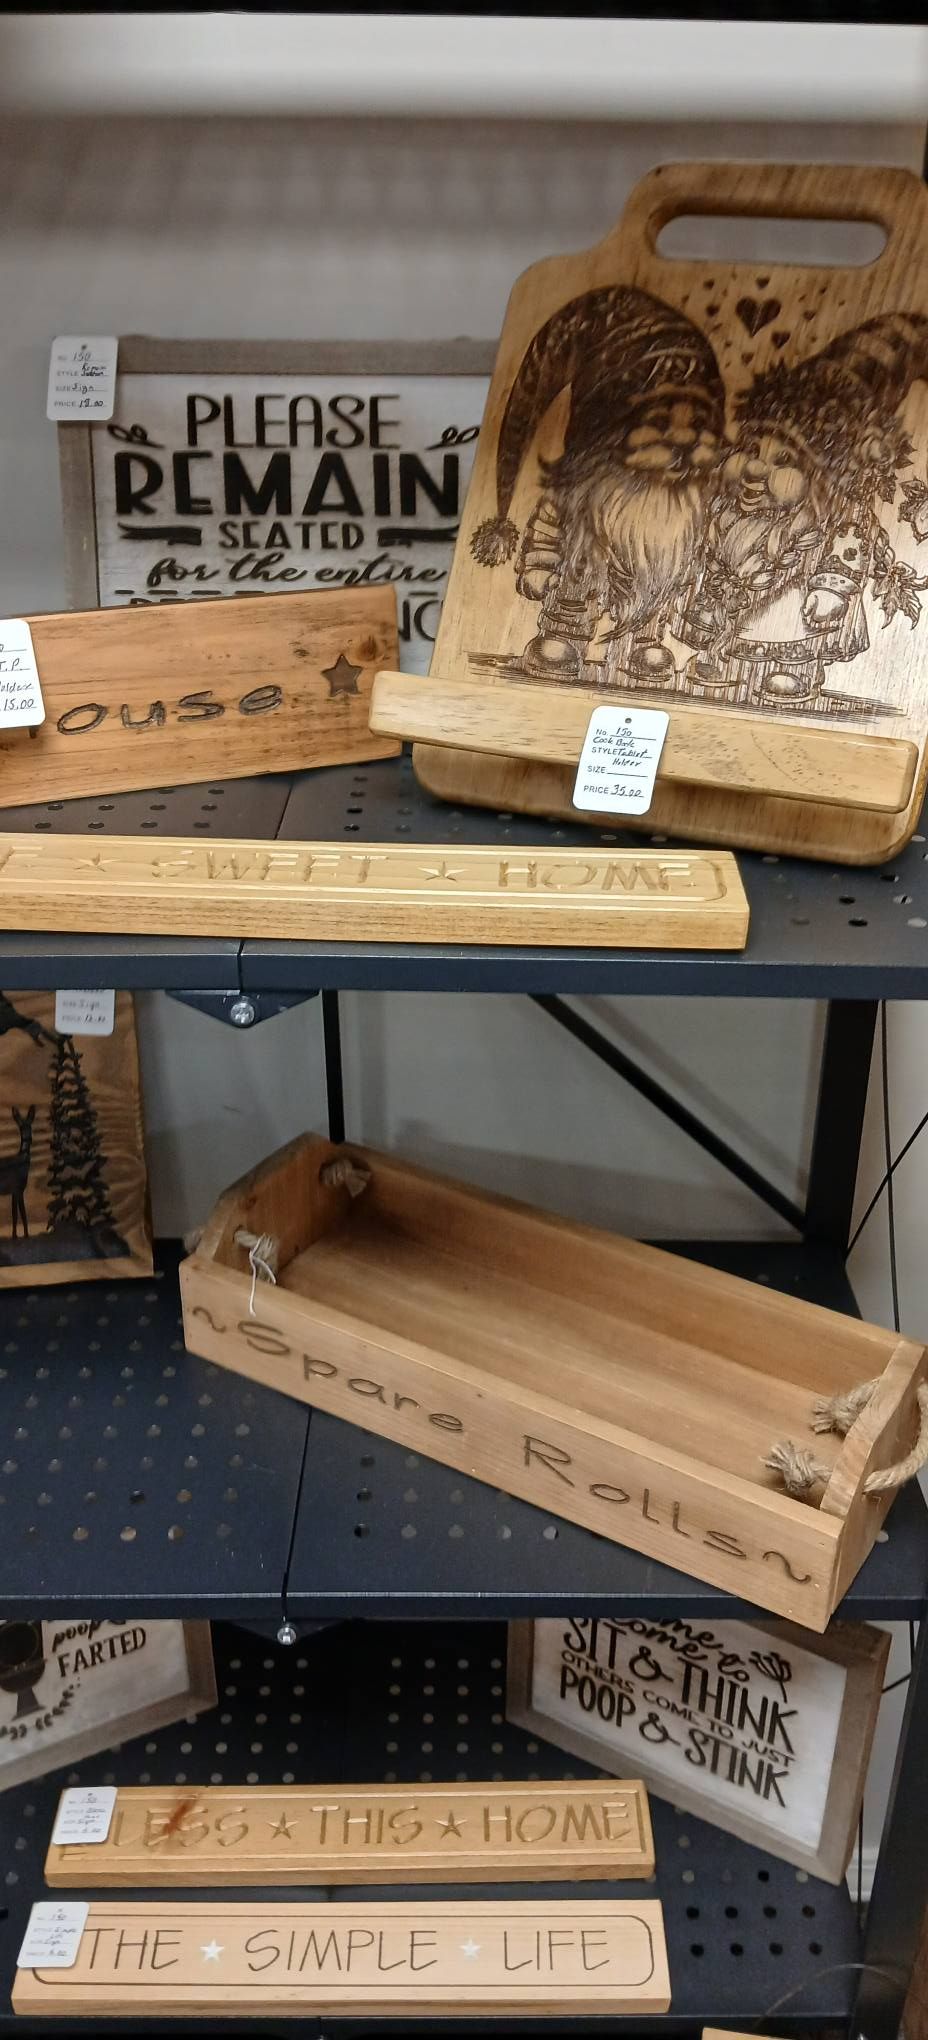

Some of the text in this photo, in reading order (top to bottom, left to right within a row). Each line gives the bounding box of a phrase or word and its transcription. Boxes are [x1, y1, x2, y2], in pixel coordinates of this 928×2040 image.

[186, 393, 400, 449] PLEASE
[114, 451, 460, 517] REMAIN
[218, 521, 365, 550] SEATED
[147, 552, 448, 587] for the entire
[3, 698, 34, 711] 15.00
[27, 684, 283, 737] ouse
[591, 746, 618, 756] STYLE
[616, 727, 632, 737] 150
[583, 785, 609, 795] PRICE
[587, 765, 606, 774] SIZE
[498, 859, 697, 891] HOME
[58, 1627, 146, 1678] FARTED
[561, 1650, 796, 1767] OTHERS COME TO JUST
[563, 1618, 798, 1755] SIT & THINK
[560, 1663, 789, 1808] POOP & STINK
[113, 1801, 632, 1847] LESS THIS HOME
[84, 1928, 610, 1972] THE SIMPLE LIFE
